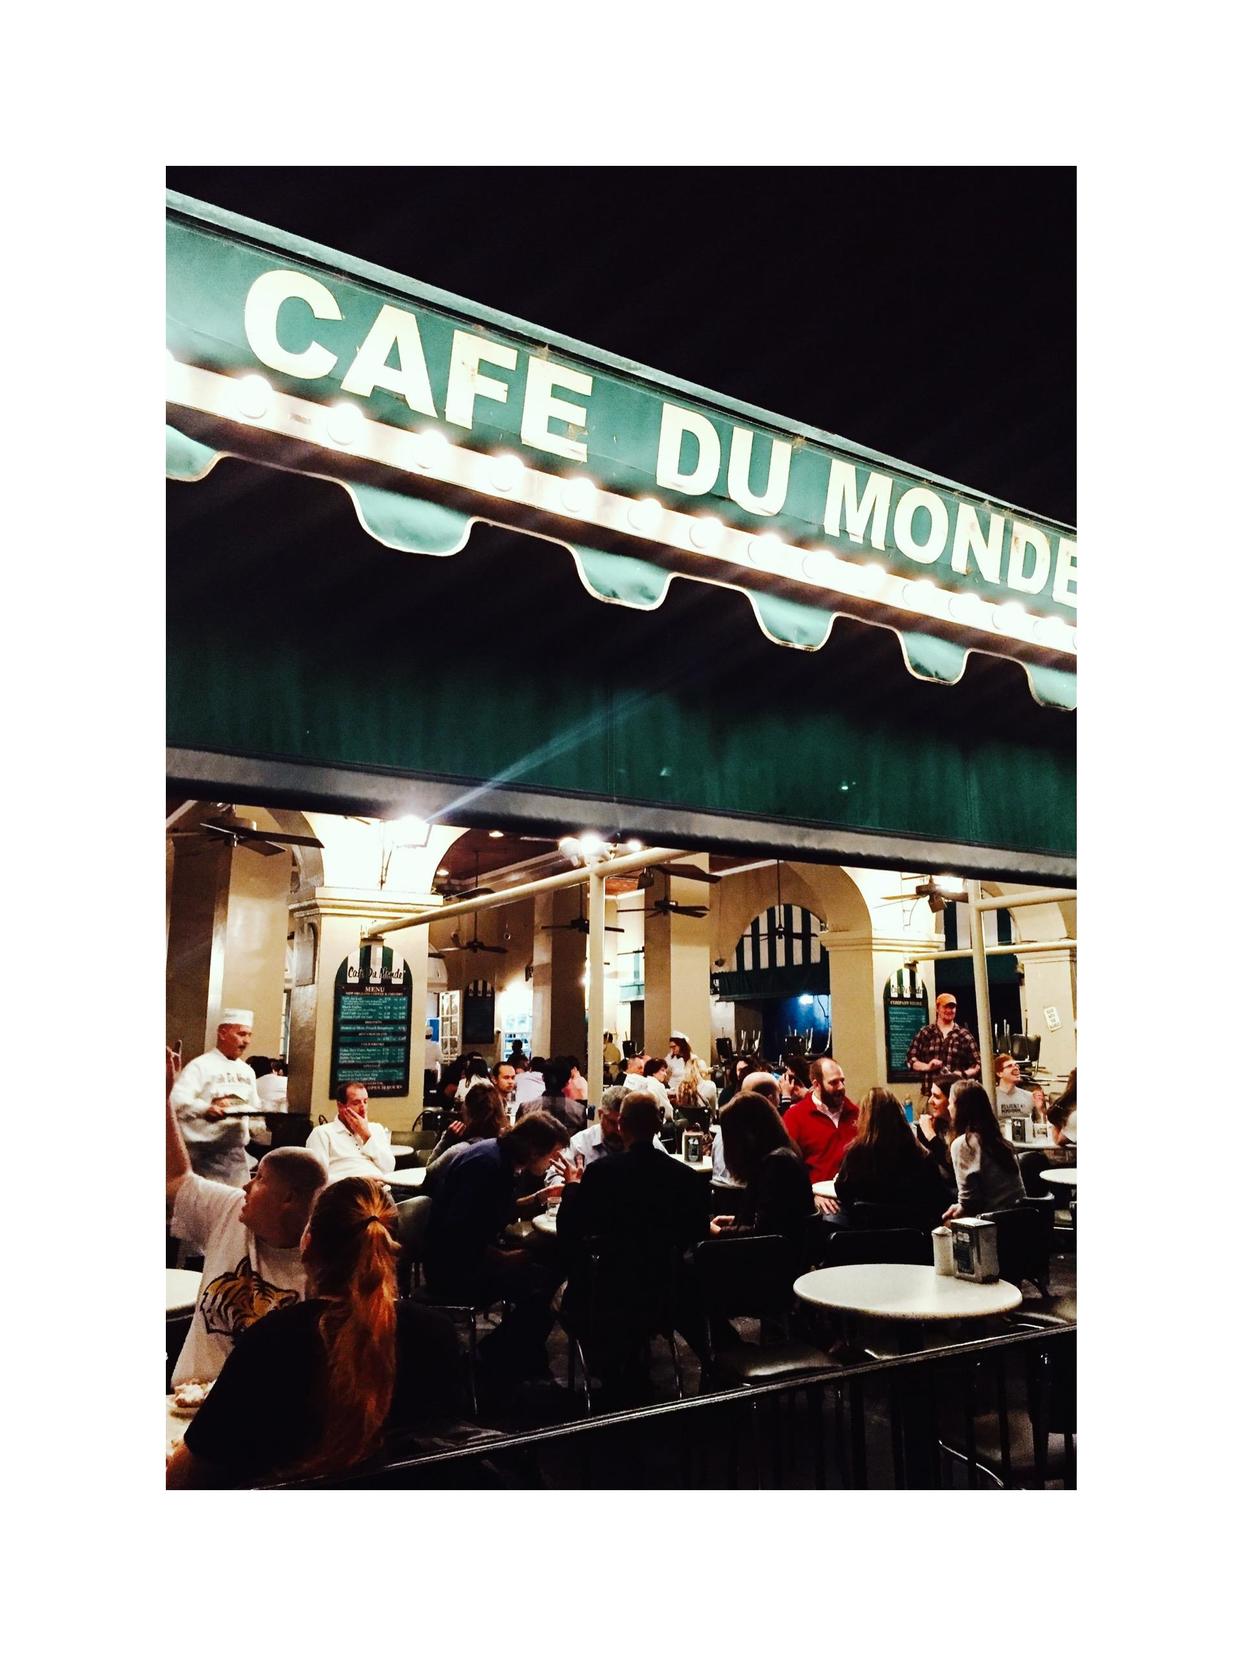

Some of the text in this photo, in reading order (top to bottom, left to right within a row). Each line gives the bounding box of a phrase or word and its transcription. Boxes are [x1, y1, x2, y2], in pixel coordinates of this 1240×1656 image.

[244, 269, 1077, 609] CAFE DU MONDE
